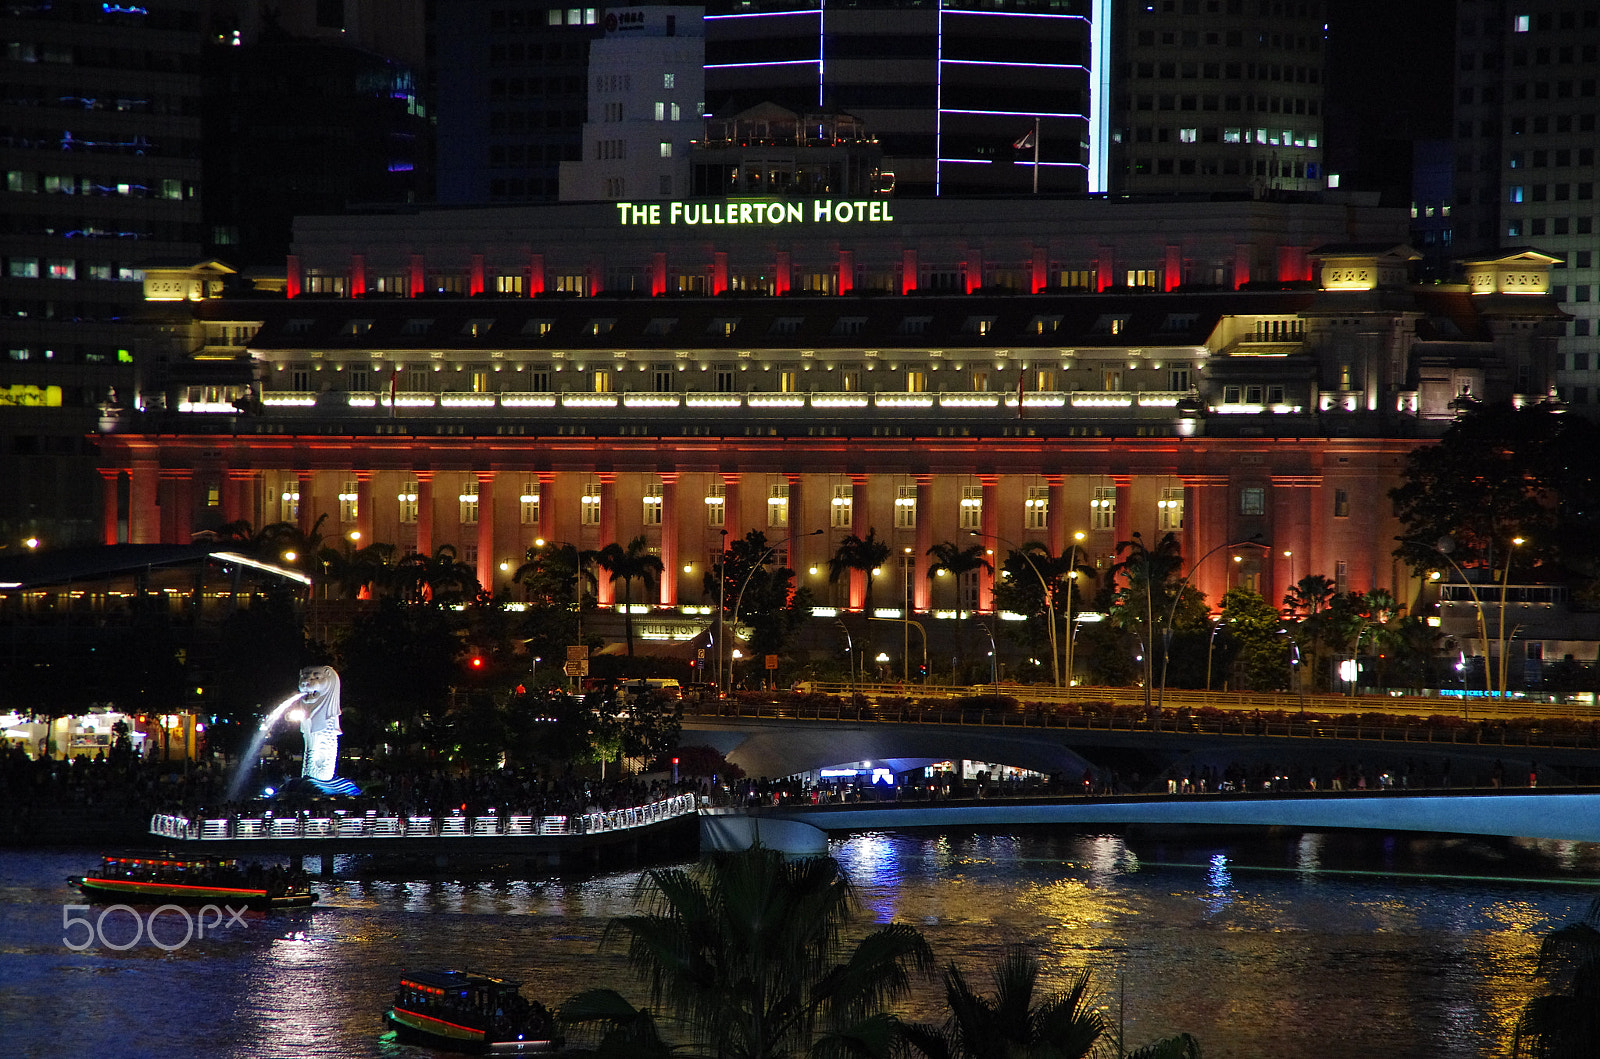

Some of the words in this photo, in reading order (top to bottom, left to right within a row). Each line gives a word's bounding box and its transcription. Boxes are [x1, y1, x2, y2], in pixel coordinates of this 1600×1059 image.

[616, 202, 661, 225] THE
[670, 202, 803, 225] FULLERTON
[814, 200, 893, 223] HOTEL
[642, 625, 694, 635] FULLERTON
